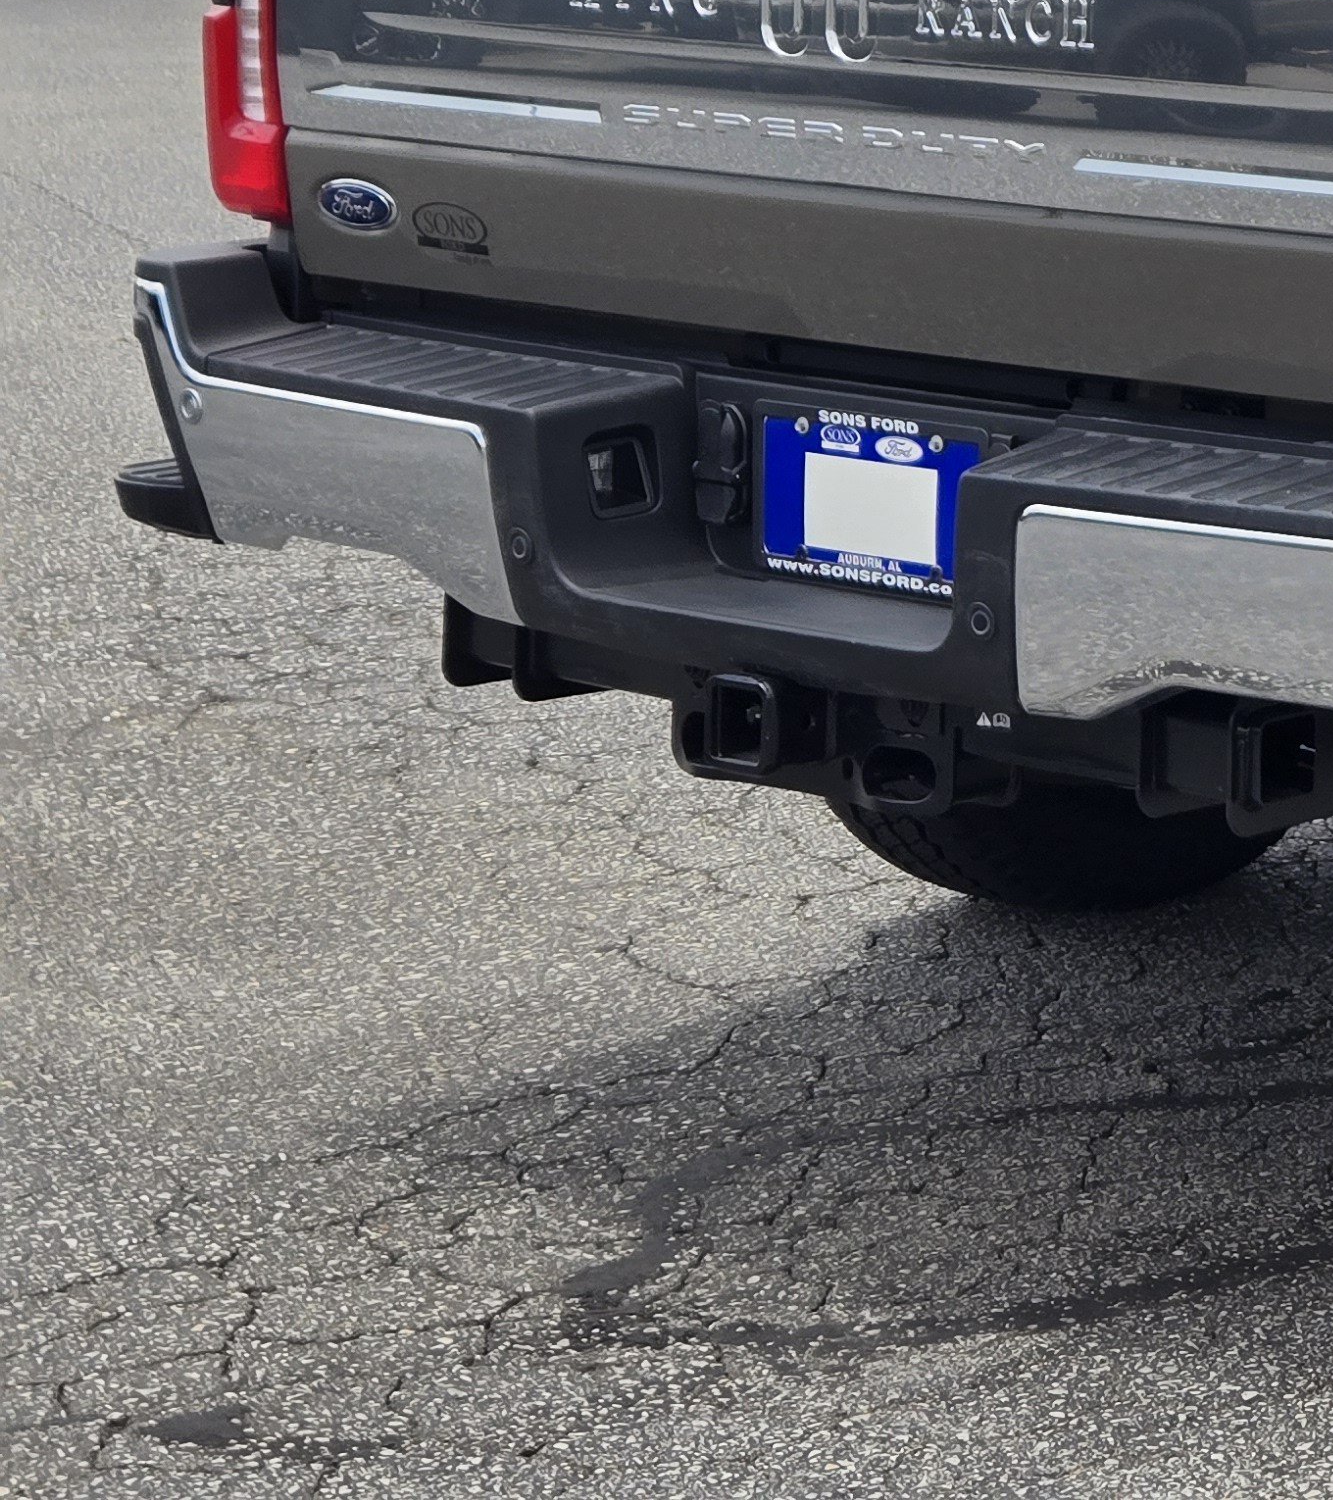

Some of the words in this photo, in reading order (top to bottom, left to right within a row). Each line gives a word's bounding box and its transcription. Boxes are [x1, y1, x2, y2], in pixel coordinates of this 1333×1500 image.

[622, 103, 844, 144] SUPER
[861, 125, 1046, 162] DUTY
[423, 209, 477, 240] SONS
[818, 409, 867, 428] SONS
[870, 416, 920, 434] FORD
[826, 427, 855, 443] SONS
[884, 439, 914, 458] Ford
[837, 552, 887, 572] AUBURN,
[887, 559, 903, 573] AL
